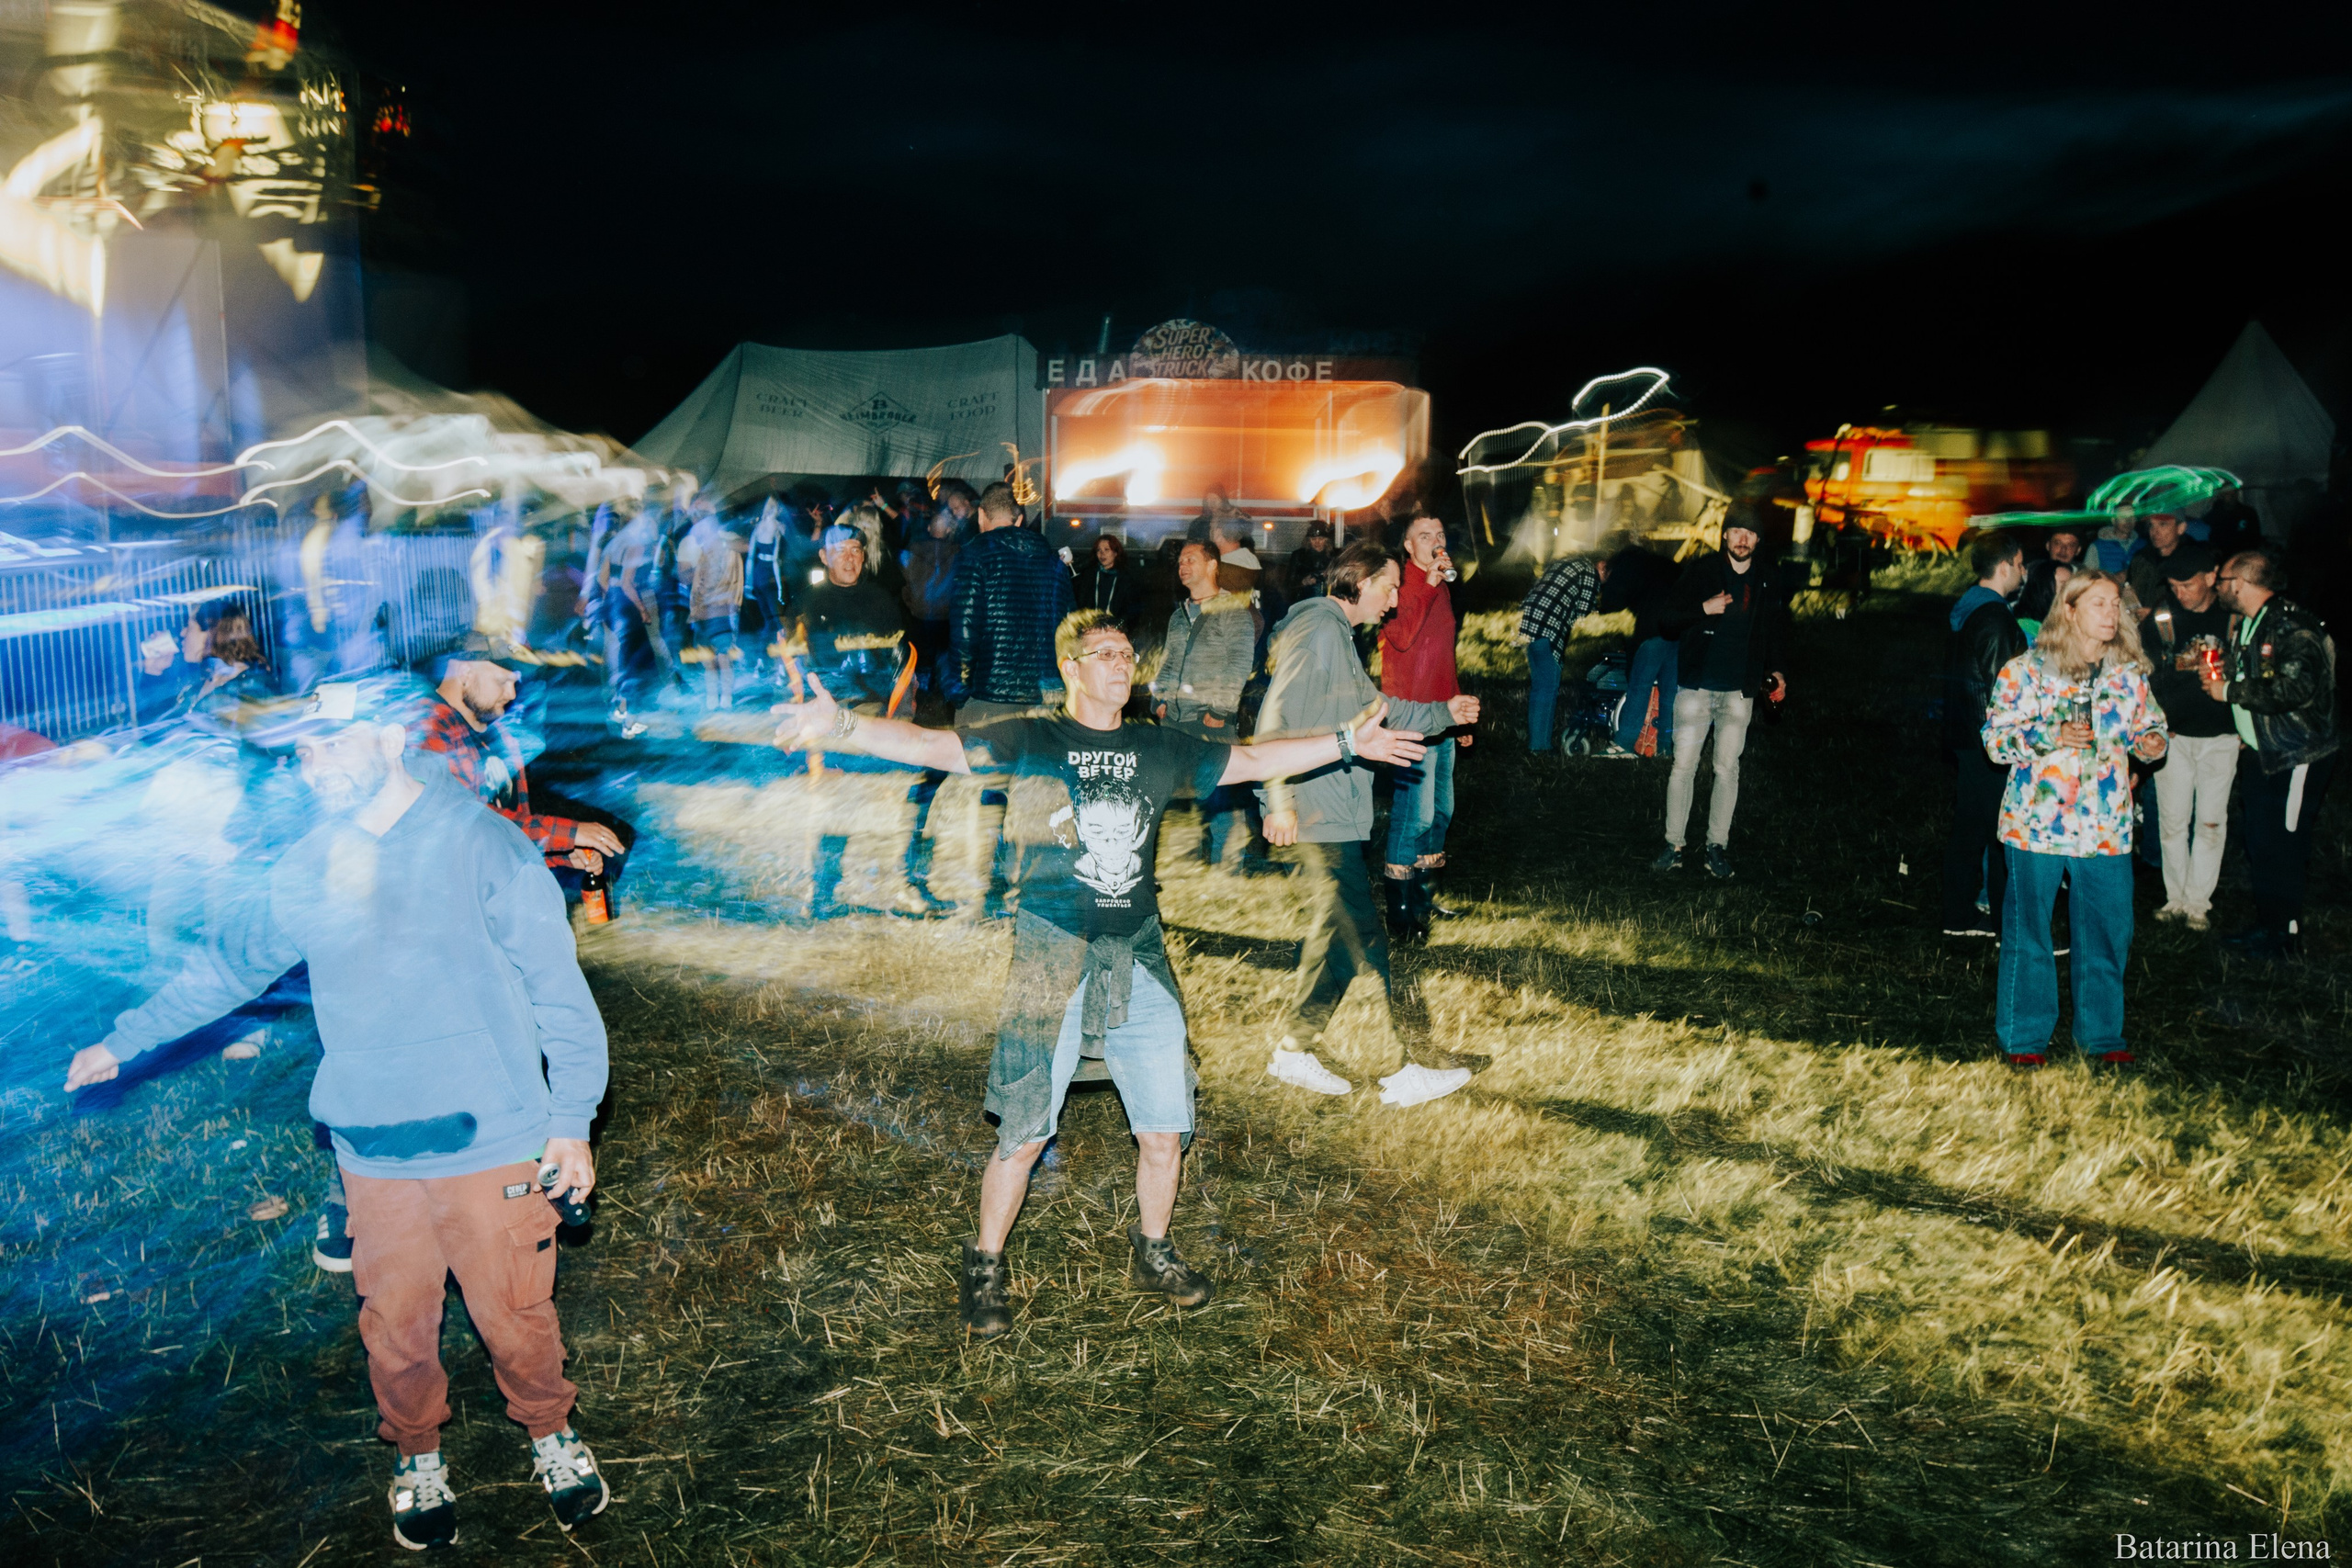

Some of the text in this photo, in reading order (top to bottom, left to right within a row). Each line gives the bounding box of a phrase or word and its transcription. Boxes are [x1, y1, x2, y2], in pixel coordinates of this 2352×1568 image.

[1153, 327, 1211, 349] SUPER
[1161, 344, 1205, 361] HERO
[1048, 359, 1126, 387] ЕДА
[1155, 359, 1211, 378] TRUCK
[1242, 359, 1333, 383] КОФЕ
[947, 390, 1001, 408] CRAFT
[949, 404, 995, 421] FOOD
[1077, 764, 1135, 781] ВЕТЕР
